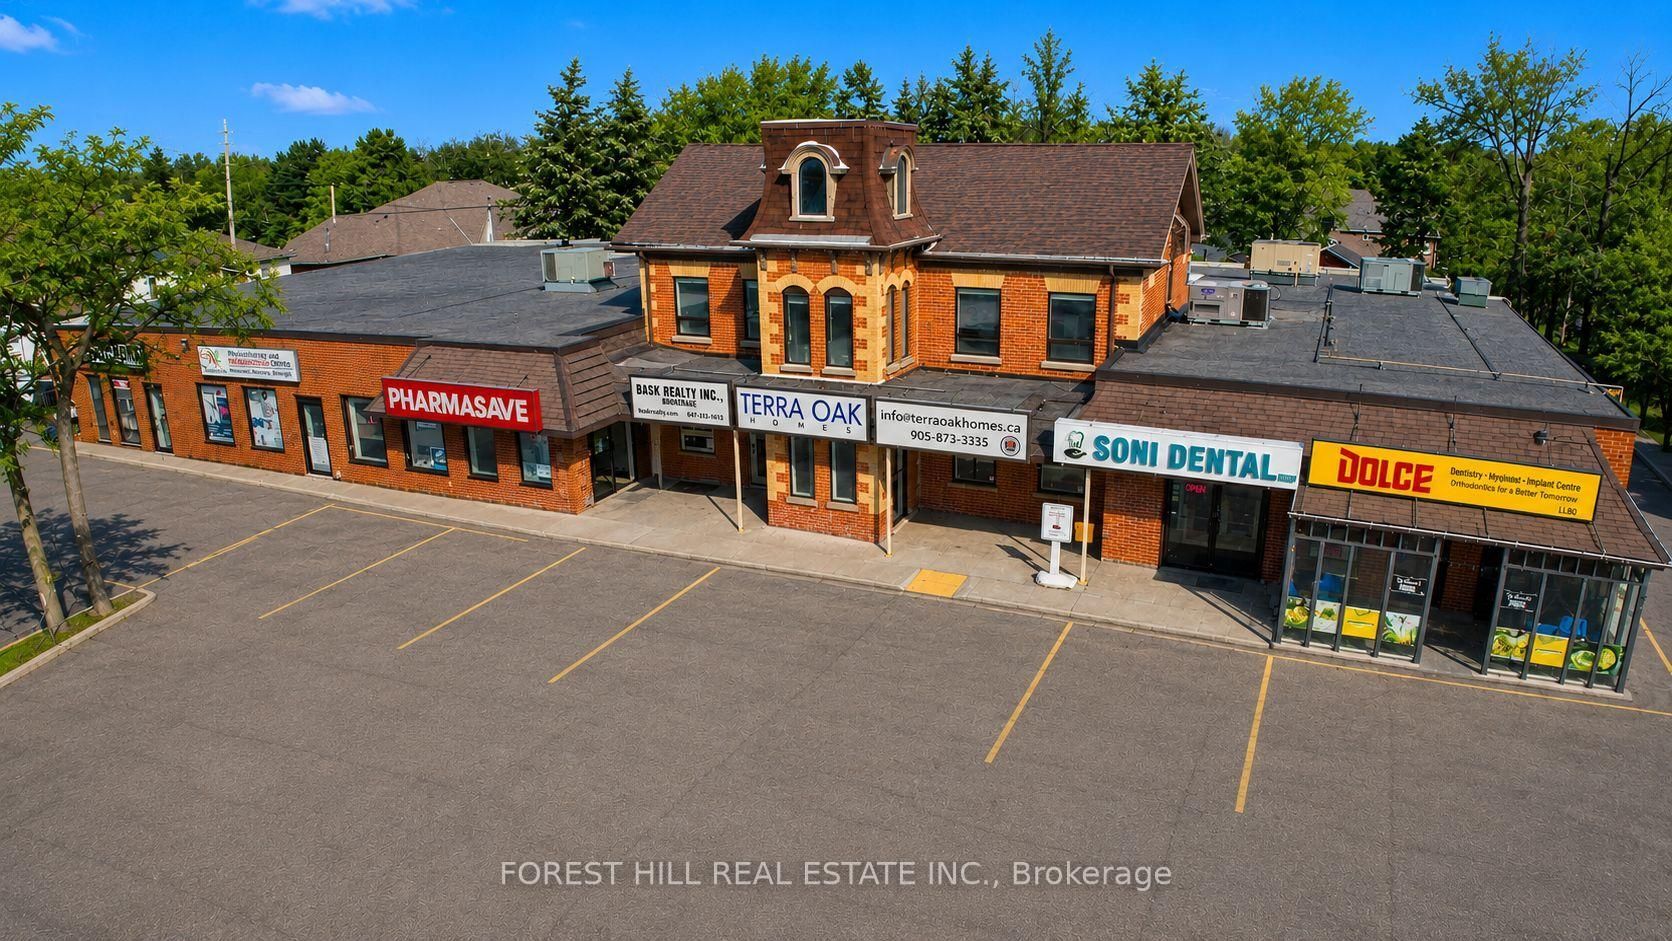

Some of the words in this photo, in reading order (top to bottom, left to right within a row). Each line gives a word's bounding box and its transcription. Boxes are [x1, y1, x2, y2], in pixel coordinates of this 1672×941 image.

[387, 387, 529, 423] PHARMASAVE
[636, 384, 661, 396] BASK
[663, 386, 697, 399] REALTY
[699, 388, 724, 403] INC.,
[740, 393, 804, 420] TERRA
[812, 399, 863, 426] OAK
[880, 409, 1021, 434] info@terraoakhomes.ca
[910, 430, 989, 448] 905-873-3335
[1092, 435, 1159, 467] SONI
[1166, 443, 1278, 481] DENTAL
[1337, 447, 1435, 494] DOLCE
[1184, 482, 1207, 494] OPEN
[1450, 466, 1483, 480] Dentistry
[1526, 477, 1555, 489] Implant
[1556, 481, 1582, 493] Centre
[1450, 479, 1496, 492] Orthodontics
[1497, 485, 1508, 494] for
[1515, 487, 1538, 498] Better
[1540, 491, 1579, 503] Tomorrow
